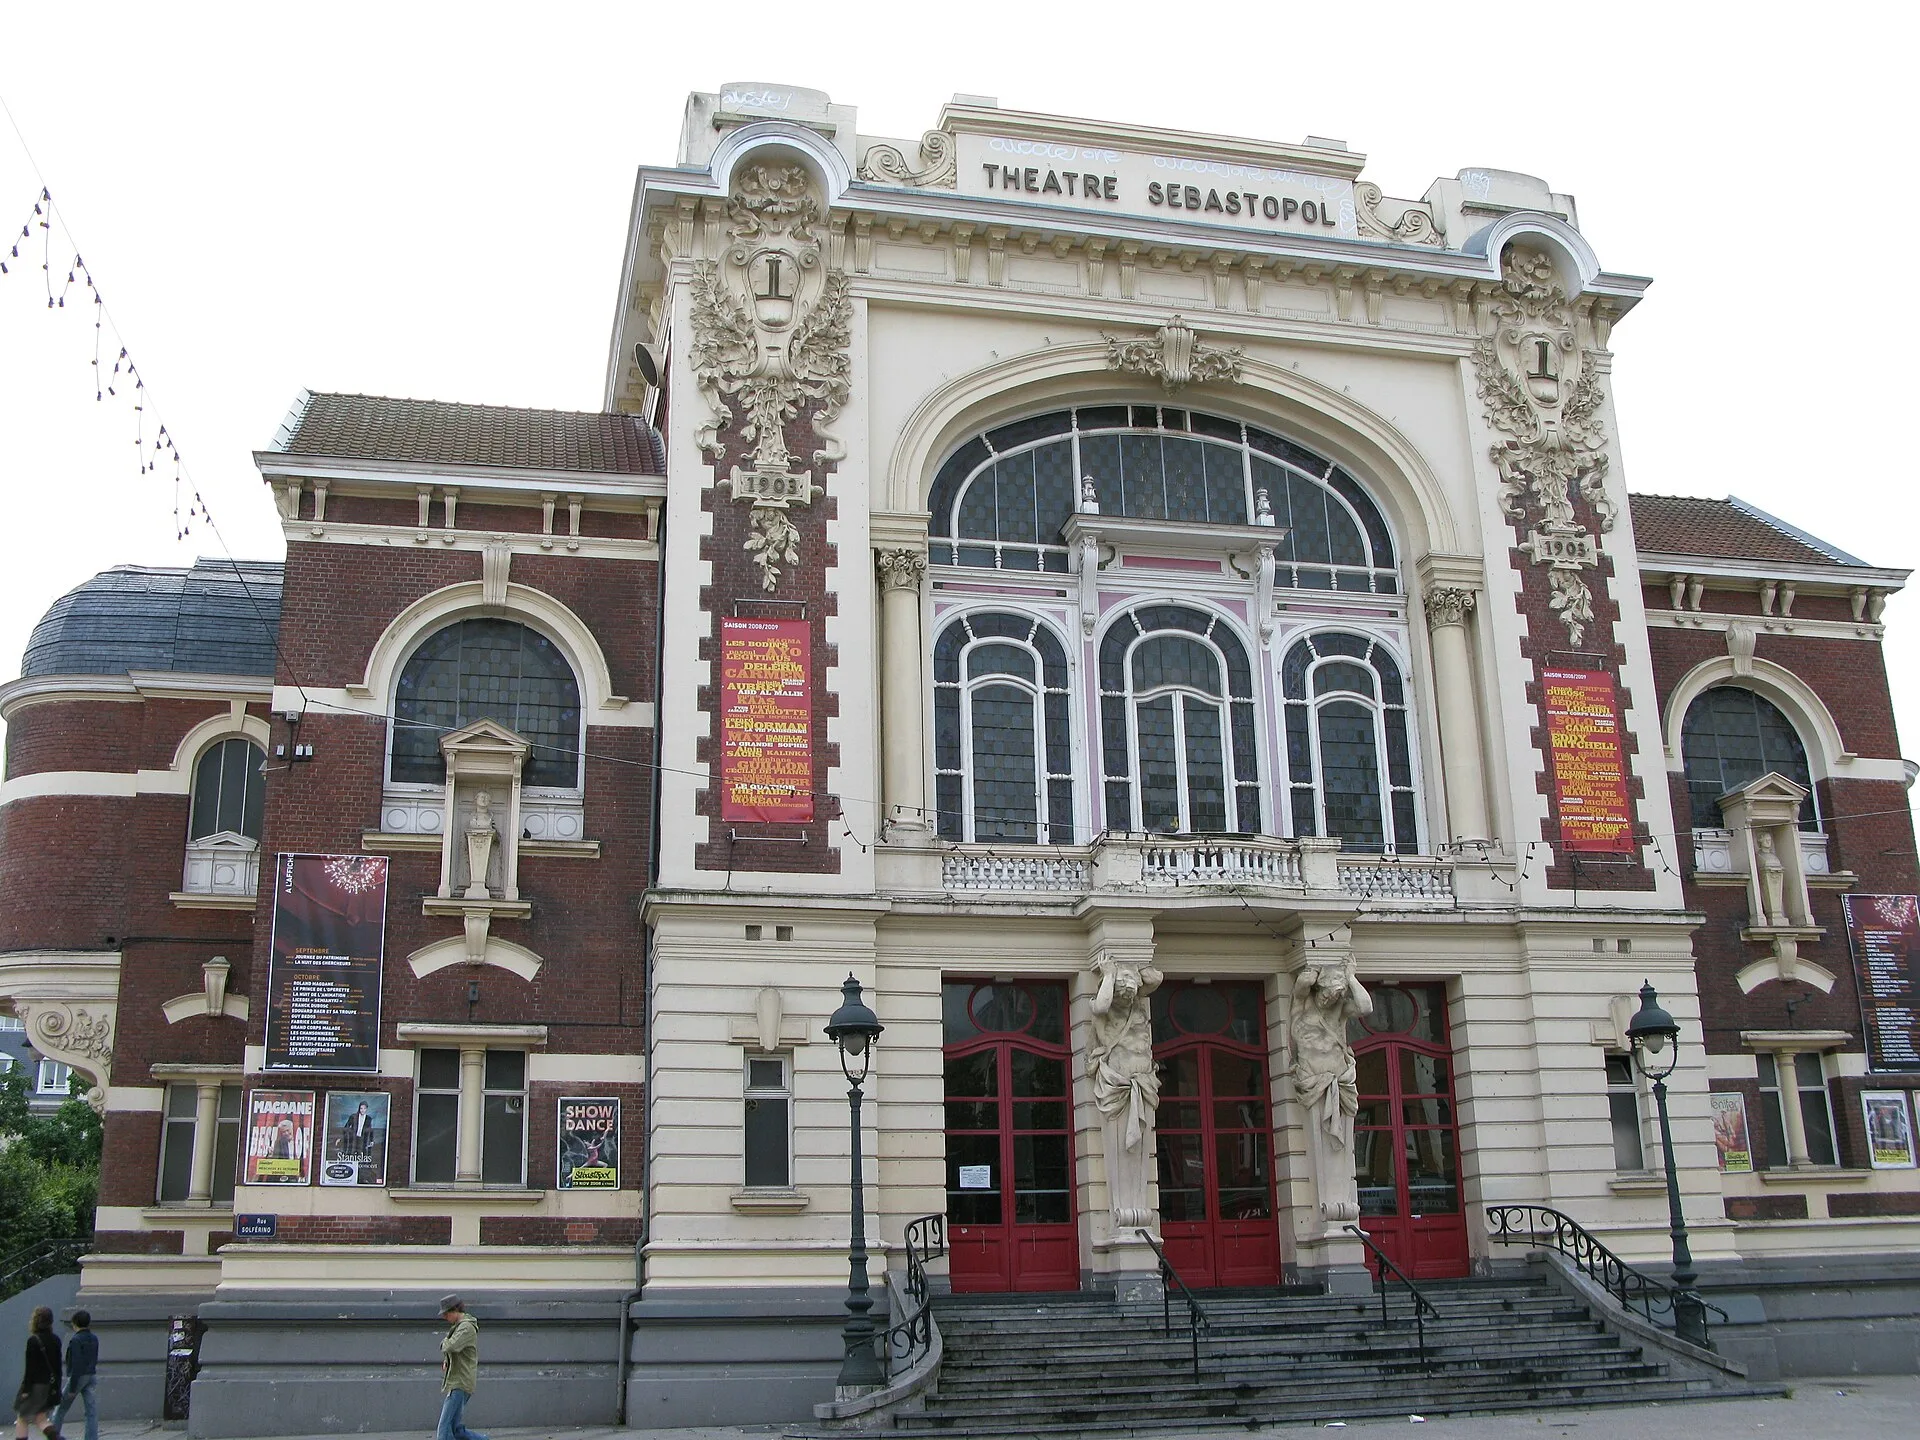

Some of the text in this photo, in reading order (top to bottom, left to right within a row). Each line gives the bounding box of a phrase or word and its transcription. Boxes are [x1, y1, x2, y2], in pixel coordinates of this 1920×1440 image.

[983, 163, 1119, 200] THEATRE
[1149, 181, 1336, 226] SEBASTOPOL
[746, 477, 797, 494] 1903
[766, 646, 802, 656] AYO
[744, 662, 802, 672] DELERM
[725, 668, 805, 680] CARMEN
[726, 682, 785, 691] AUBRET
[1566, 706, 1610, 714] LUCHINI
[725, 720, 808, 730] LENORMAN
[1554, 716, 1594, 726] SOLO
[1565, 724, 1614, 734] CAMILLE
[1552, 734, 1587, 742] EDDY
[1552, 740, 1618, 750] MITCHELL
[737, 760, 809, 770] GUILLON
[1562, 789, 1616, 798] MAGDANE
[732, 796, 782, 804] MOREAU
[286, 854, 294, 887] L'AFFICHE
[254, 1100, 312, 1114] MAGDANE
[566, 1106, 612, 1118] SHOW
[566, 1120, 614, 1131] DANCE
[337, 1152, 372, 1162] Stanislas
